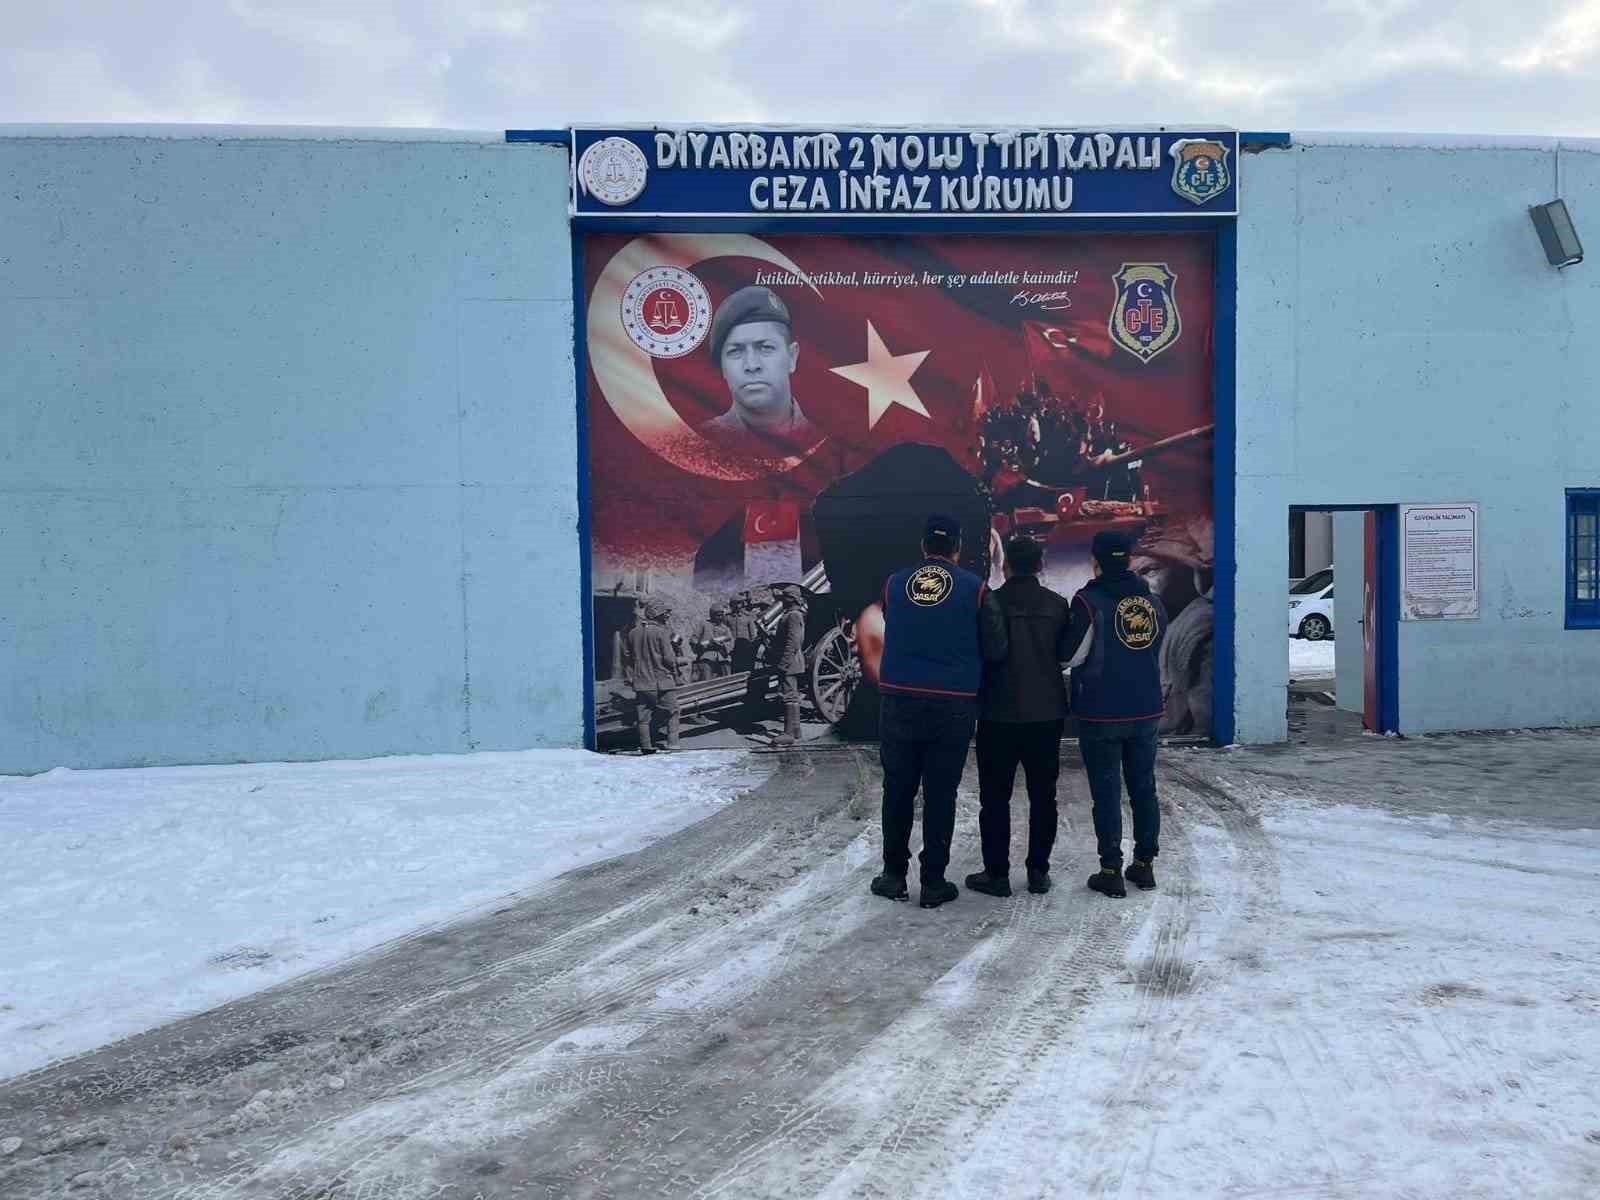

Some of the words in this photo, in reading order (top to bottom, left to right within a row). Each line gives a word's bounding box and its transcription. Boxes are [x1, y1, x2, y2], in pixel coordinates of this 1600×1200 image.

[655, 131, 841, 169] DİYARBAKIR
[849, 137, 865, 169] 2
[871, 134, 963, 170] NOLU
[970, 132, 989, 168] T
[991, 131, 1048, 169] TİPİ
[1054, 133, 1161, 169] KAPALI
[750, 176, 830, 210] CEZA
[840, 170, 931, 211] İNFAZ
[941, 175, 1073, 211] KURUMU
[1192, 170, 1215, 186] CTE
[755, 268, 804, 287] İstiklal,
[808, 271, 859, 287] istikbal,
[863, 271, 918, 288] hürriyet,
[922, 271, 944, 285] her
[946, 273, 966, 288] şey
[970, 271, 1019, 285] adaletle
[1022, 270, 1079, 285] kaimdir!
[1126, 299, 1163, 334] CTE
